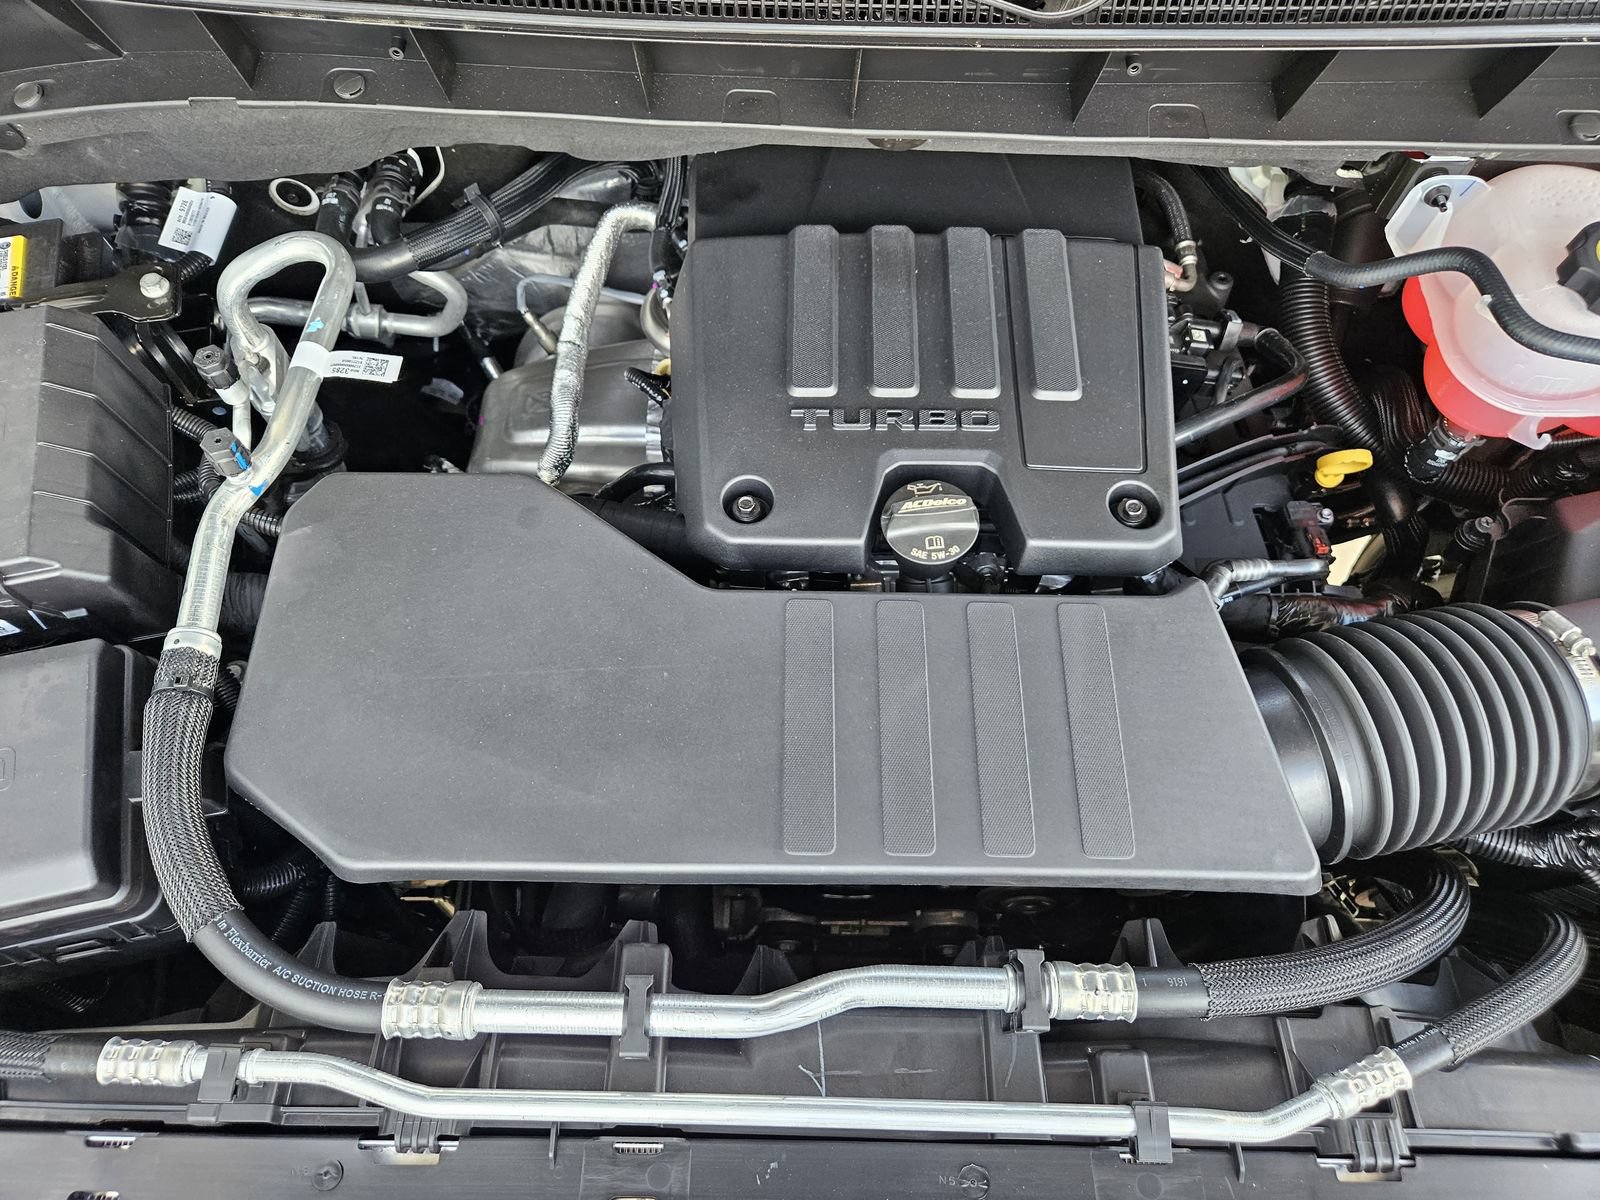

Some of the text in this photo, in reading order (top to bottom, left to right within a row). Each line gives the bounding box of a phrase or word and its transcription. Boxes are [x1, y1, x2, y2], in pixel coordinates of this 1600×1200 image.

[9, 272, 19, 297] DANGE
[790, 408, 1001, 432] TURBO
[899, 497, 967, 513] ACDelco
[911, 545, 960, 560] SAE 5W-30
[224, 927, 271, 968] Flexbarrier
[272, 965, 292, 979] A/C
[291, 974, 337, 996] SUCTION
[338, 987, 367, 1000] HOSE
